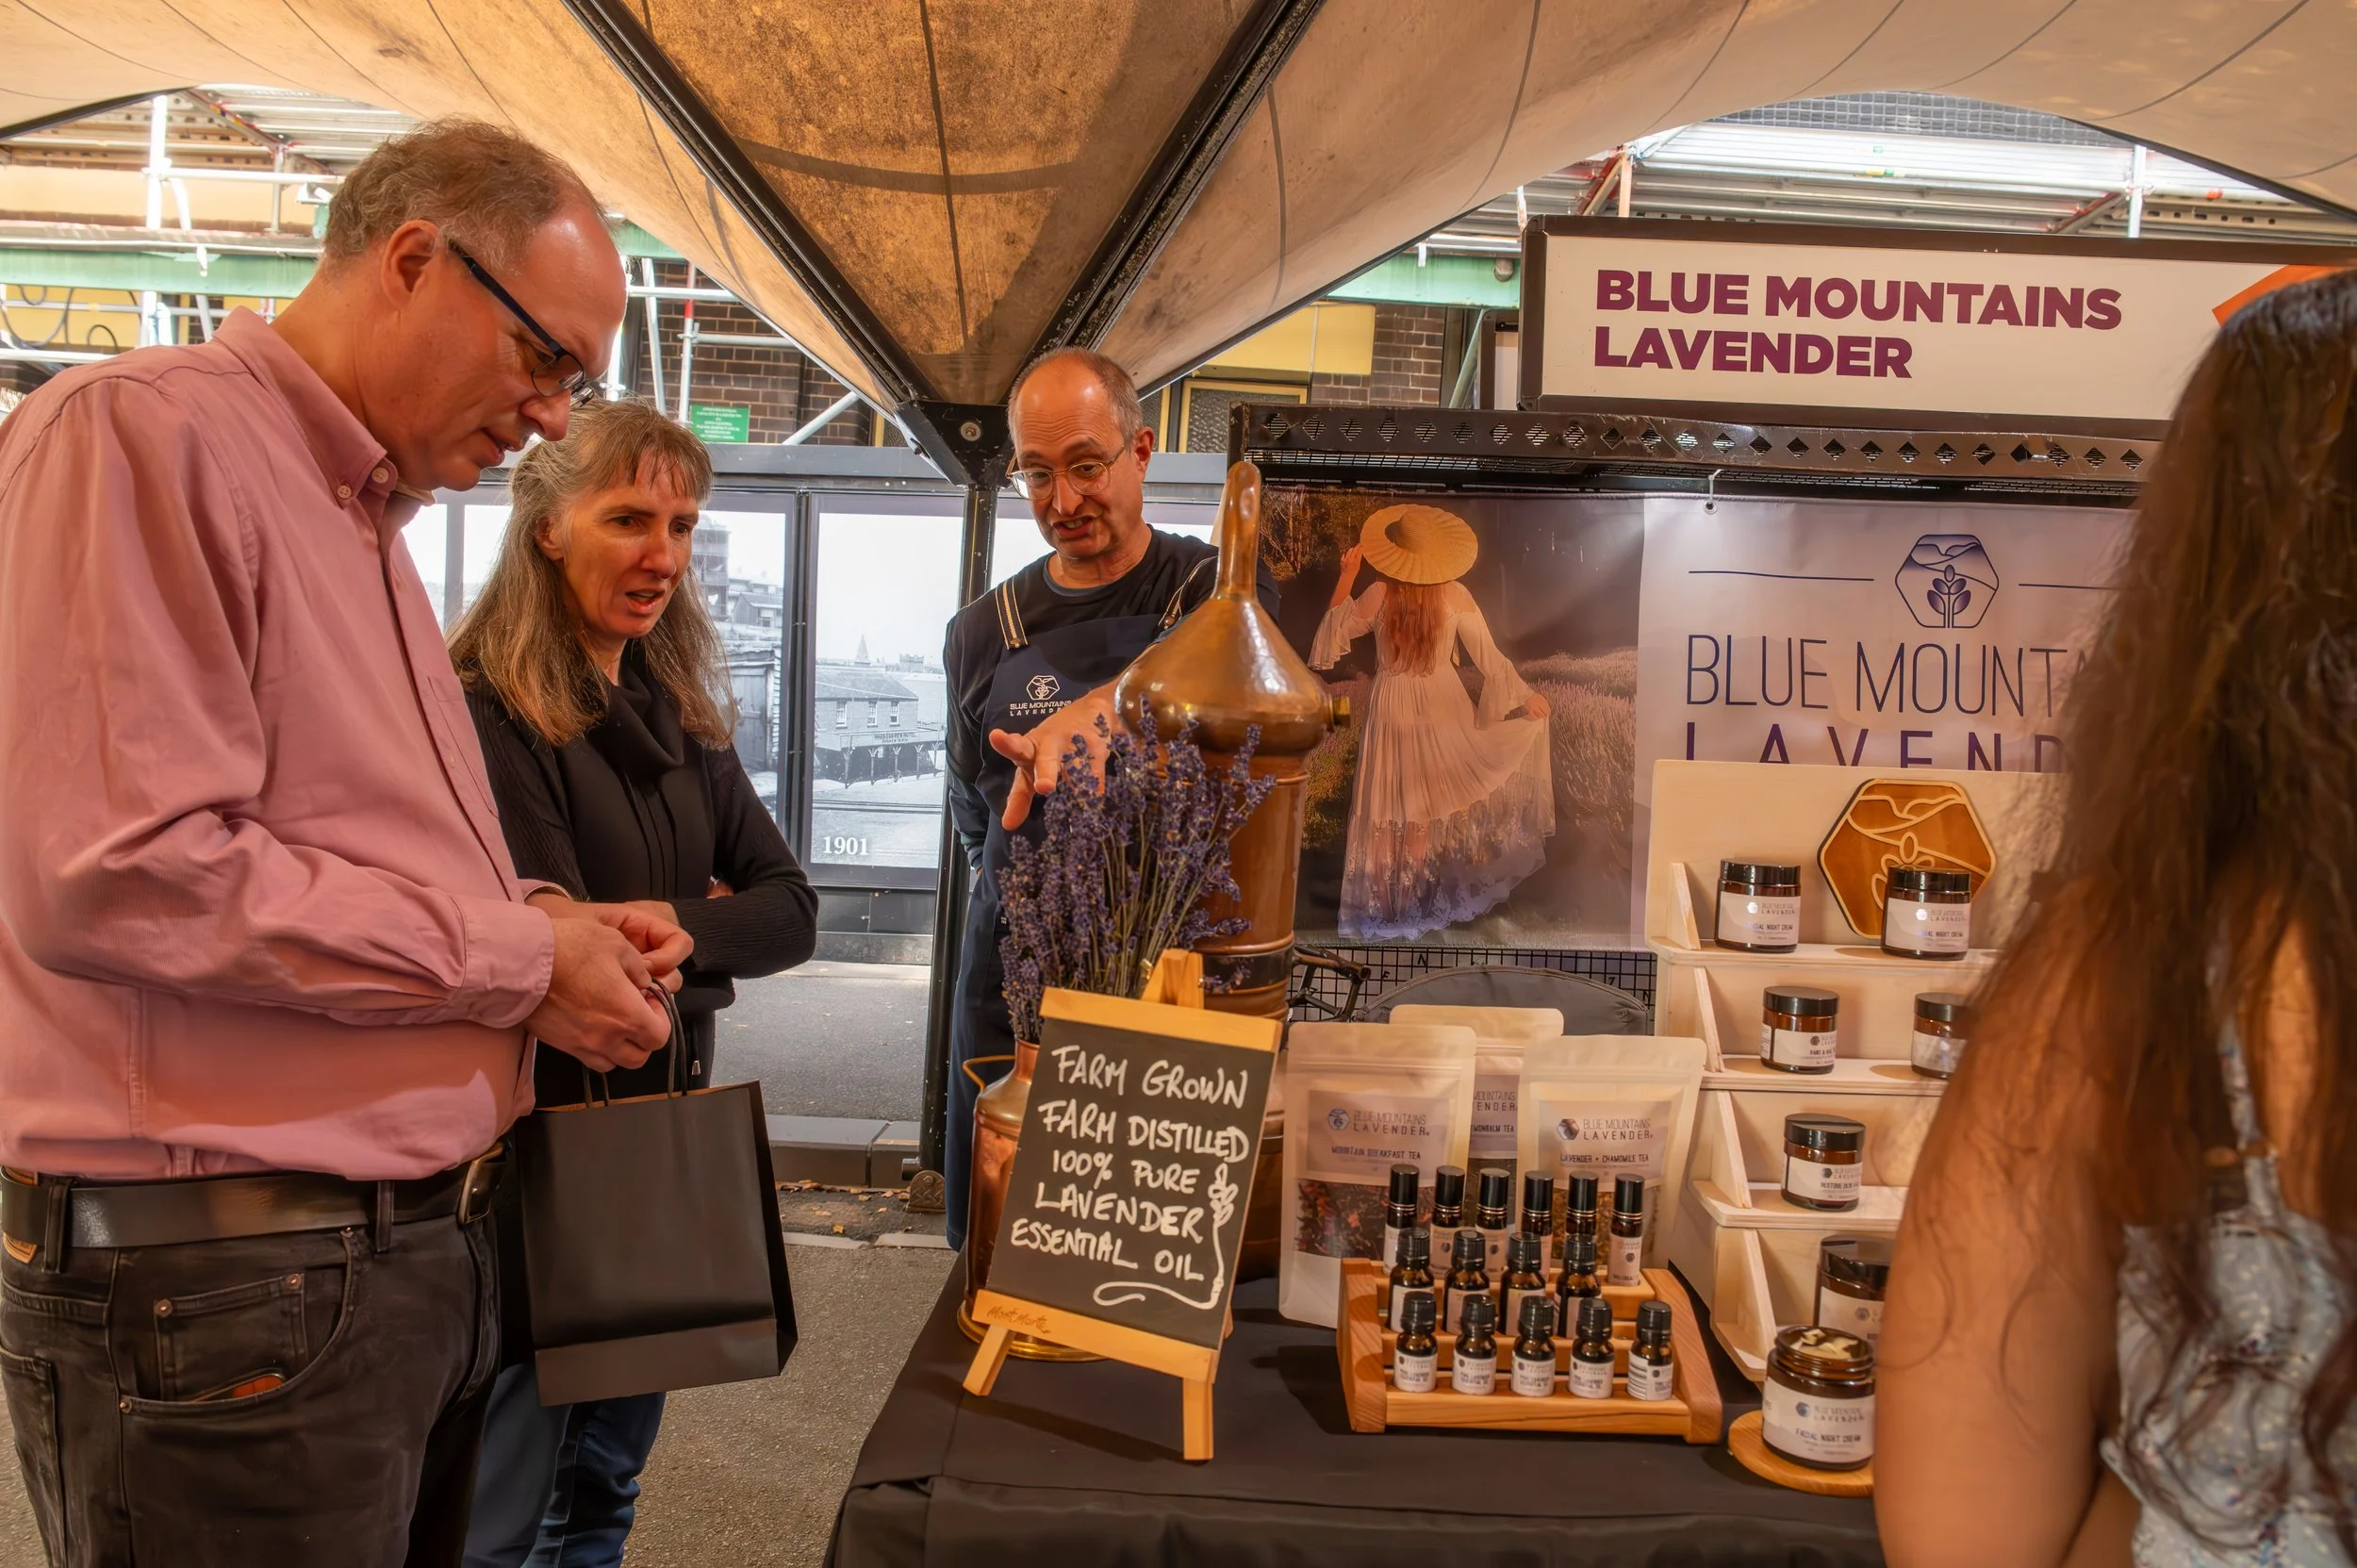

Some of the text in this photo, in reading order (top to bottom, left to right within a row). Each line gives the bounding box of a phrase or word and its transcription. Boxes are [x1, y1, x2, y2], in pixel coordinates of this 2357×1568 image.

[1596, 269, 2122, 331] BLUE MOUNTAINS
[1594, 326, 1913, 378] LAVENDER
[1687, 634, 2086, 718] BLUE MOUNT
[1030, 700, 1072, 709] MOUNTAINS
[823, 836, 868, 855] 1901
[1051, 1045, 1248, 1109] FARM GROWN
[1377, 1112, 1426, 1126] MOUNTAINS
[1475, 1102, 1516, 1112] ENDER
[1584, 1118, 1651, 1130] BLUE MOUNTAINS
[1038, 1098, 1249, 1163] FARM DISTILLED
[1053, 1149, 1200, 1194] 100% PURE
[1409, 1151, 1421, 1160] TEA
[1561, 1153, 1592, 1164] LAVENDER
[1602, 1154, 1636, 1164] CHAMOMILE
[1639, 1154, 1649, 1163] TEA
[1035, 1181, 1204, 1244] LAVENDER
[1011, 1218, 1204, 1281] ESSENTIAL OIL
